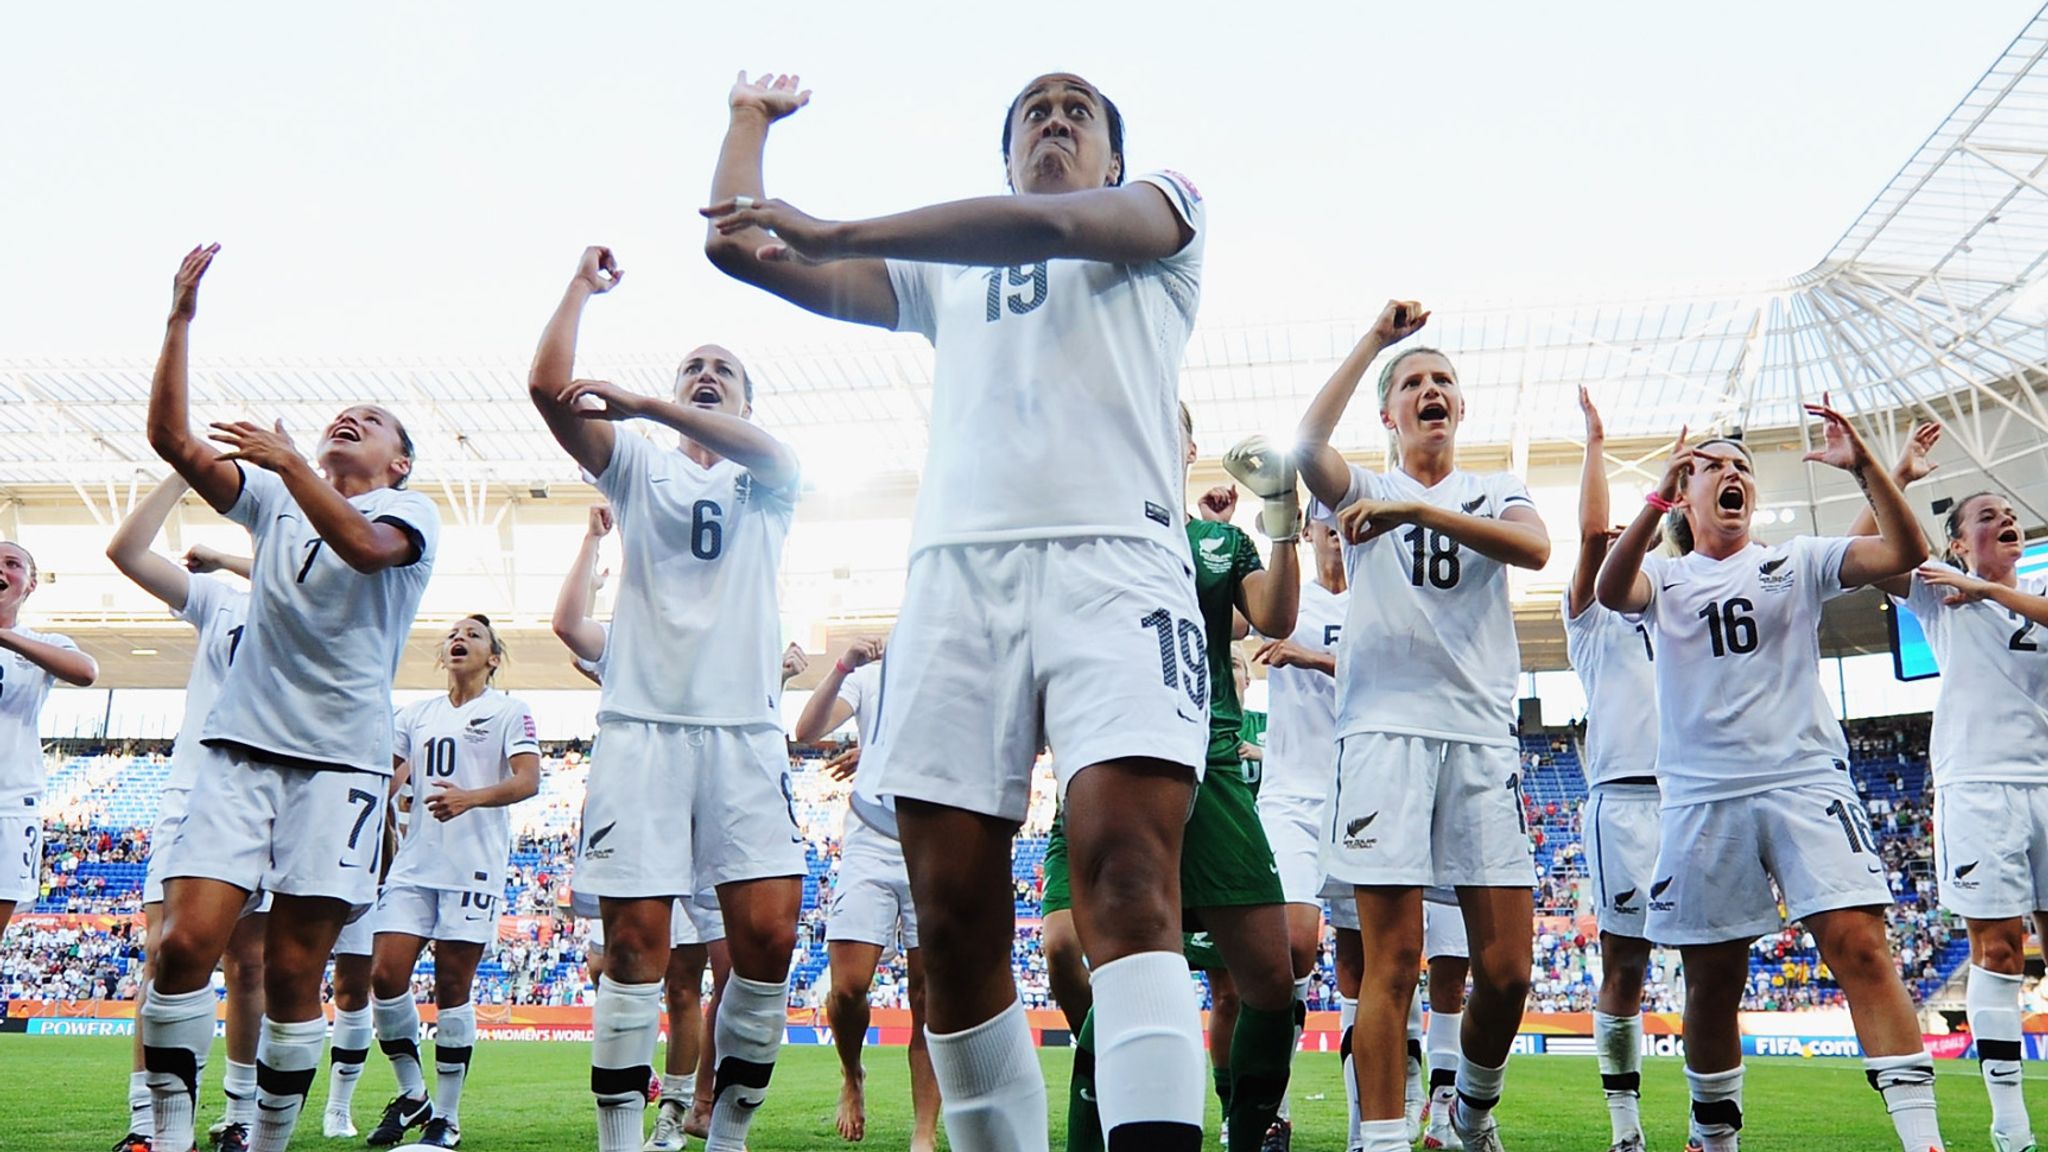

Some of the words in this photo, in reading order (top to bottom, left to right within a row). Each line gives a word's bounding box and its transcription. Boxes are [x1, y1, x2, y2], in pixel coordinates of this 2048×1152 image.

[983, 260, 1048, 322] 19
[691, 499, 722, 560] 6
[1404, 524, 1460, 590] 18
[296, 537, 324, 584] 7
[1698, 597, 1758, 658] 16
[1141, 607, 1207, 711] 19
[423, 736, 456, 777] 10
[348, 788, 377, 849] 7
[1825, 799, 1879, 856] 16
[493, 1029, 550, 1041] WOMEN'S
[1756, 1037, 1860, 1057] FIFA.com
